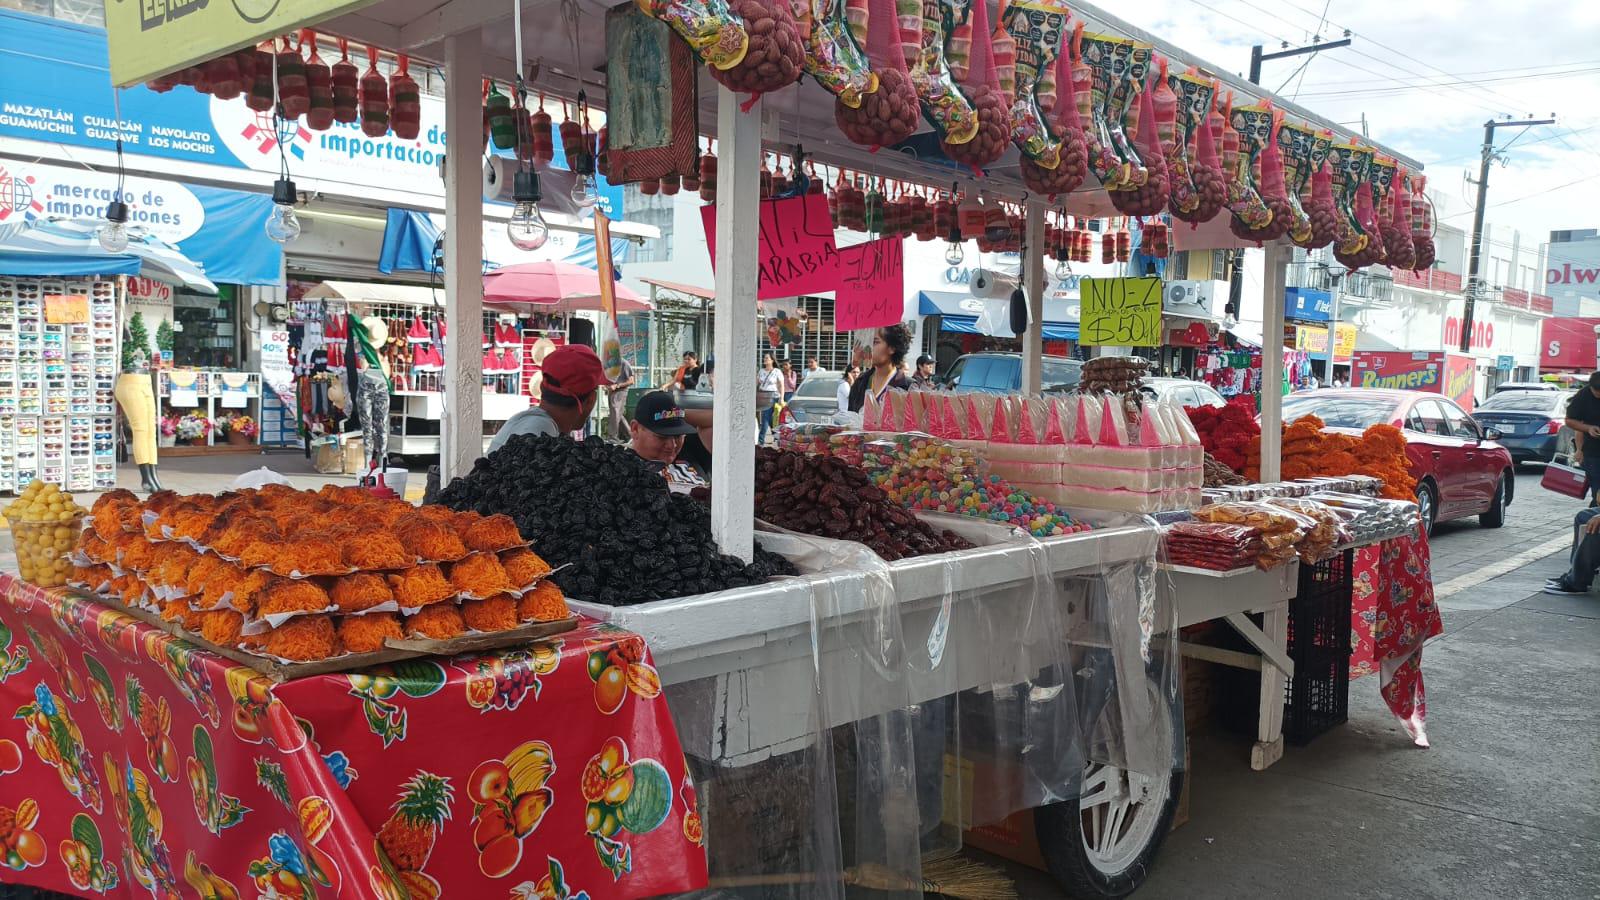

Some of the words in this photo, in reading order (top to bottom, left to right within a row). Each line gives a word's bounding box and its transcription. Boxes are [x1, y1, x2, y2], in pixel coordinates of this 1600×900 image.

[0, 115, 76, 135] GUAMÚCHIL
[86, 128, 139, 144] GUASAVE
[148, 136, 169, 148] LOS
[172, 140, 215, 154] MOCHIS
[4, 103, 73, 122] MAZATLÁN
[83, 115, 142, 132] CULIACÁN
[152, 126, 210, 142] NAVOLATO
[320, 134, 445, 167] importacion
[54, 183, 135, 203] mercado
[143, 191, 164, 206] de
[1445, 316, 1493, 348] miano
[1362, 369, 1438, 389] Runners
